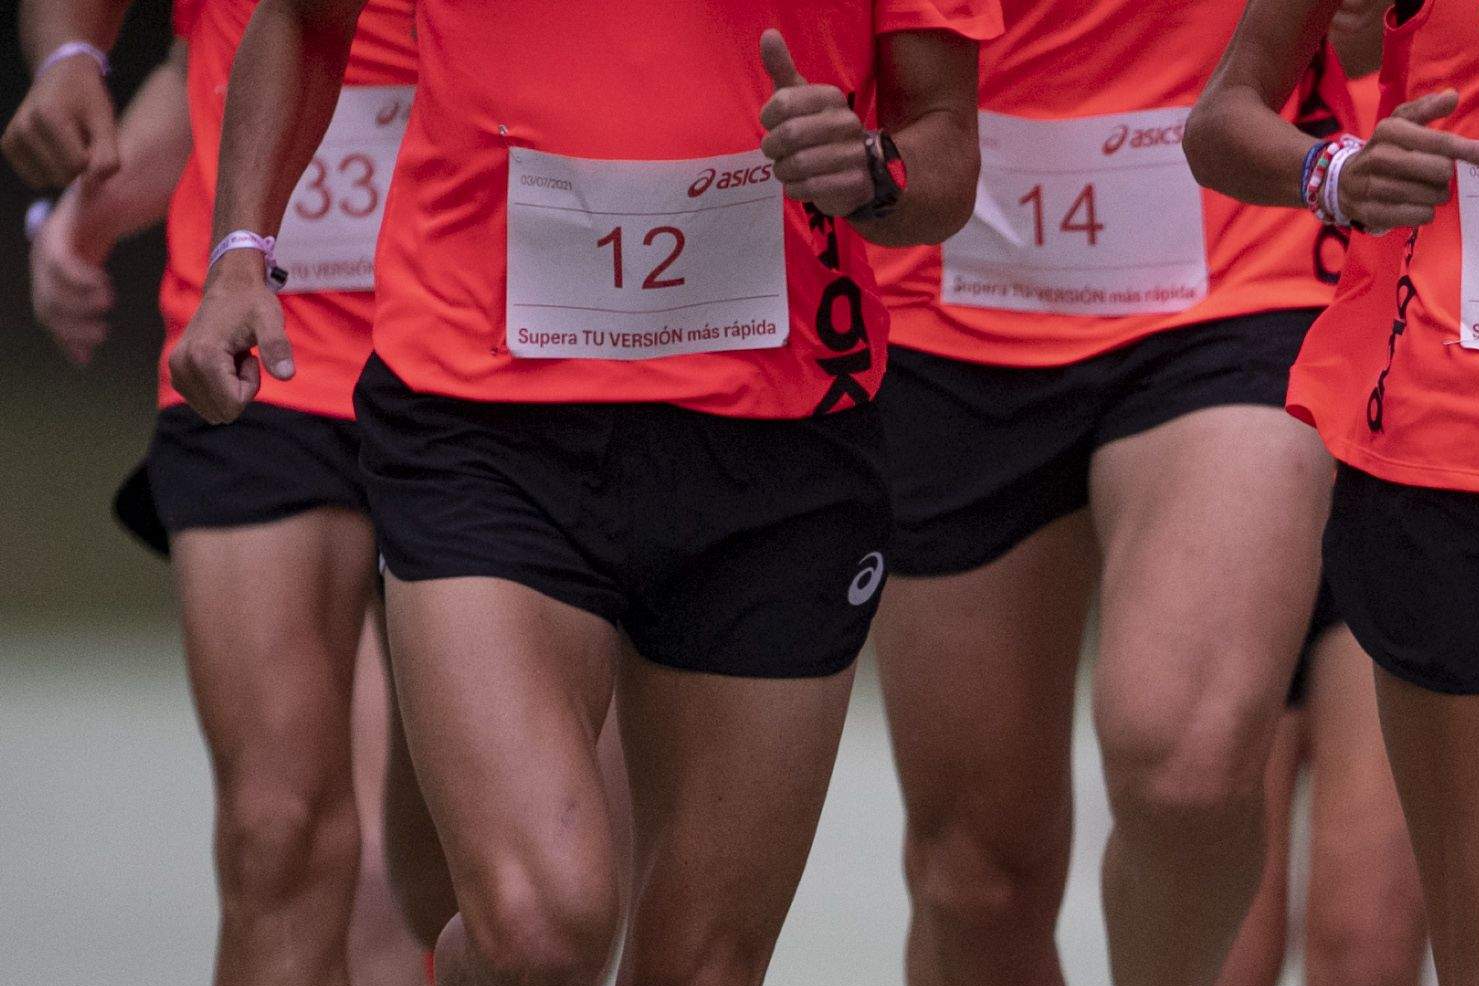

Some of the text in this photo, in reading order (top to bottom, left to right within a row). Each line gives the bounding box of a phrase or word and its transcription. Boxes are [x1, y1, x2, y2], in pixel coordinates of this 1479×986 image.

[295, 153, 378, 220] 33
[520, 174, 573, 191] 03/07/2021
[1018, 182, 1104, 247] 14
[596, 225, 686, 290] 12
[517, 319, 777, 348] Supera TU VERSIÓN más rápida
